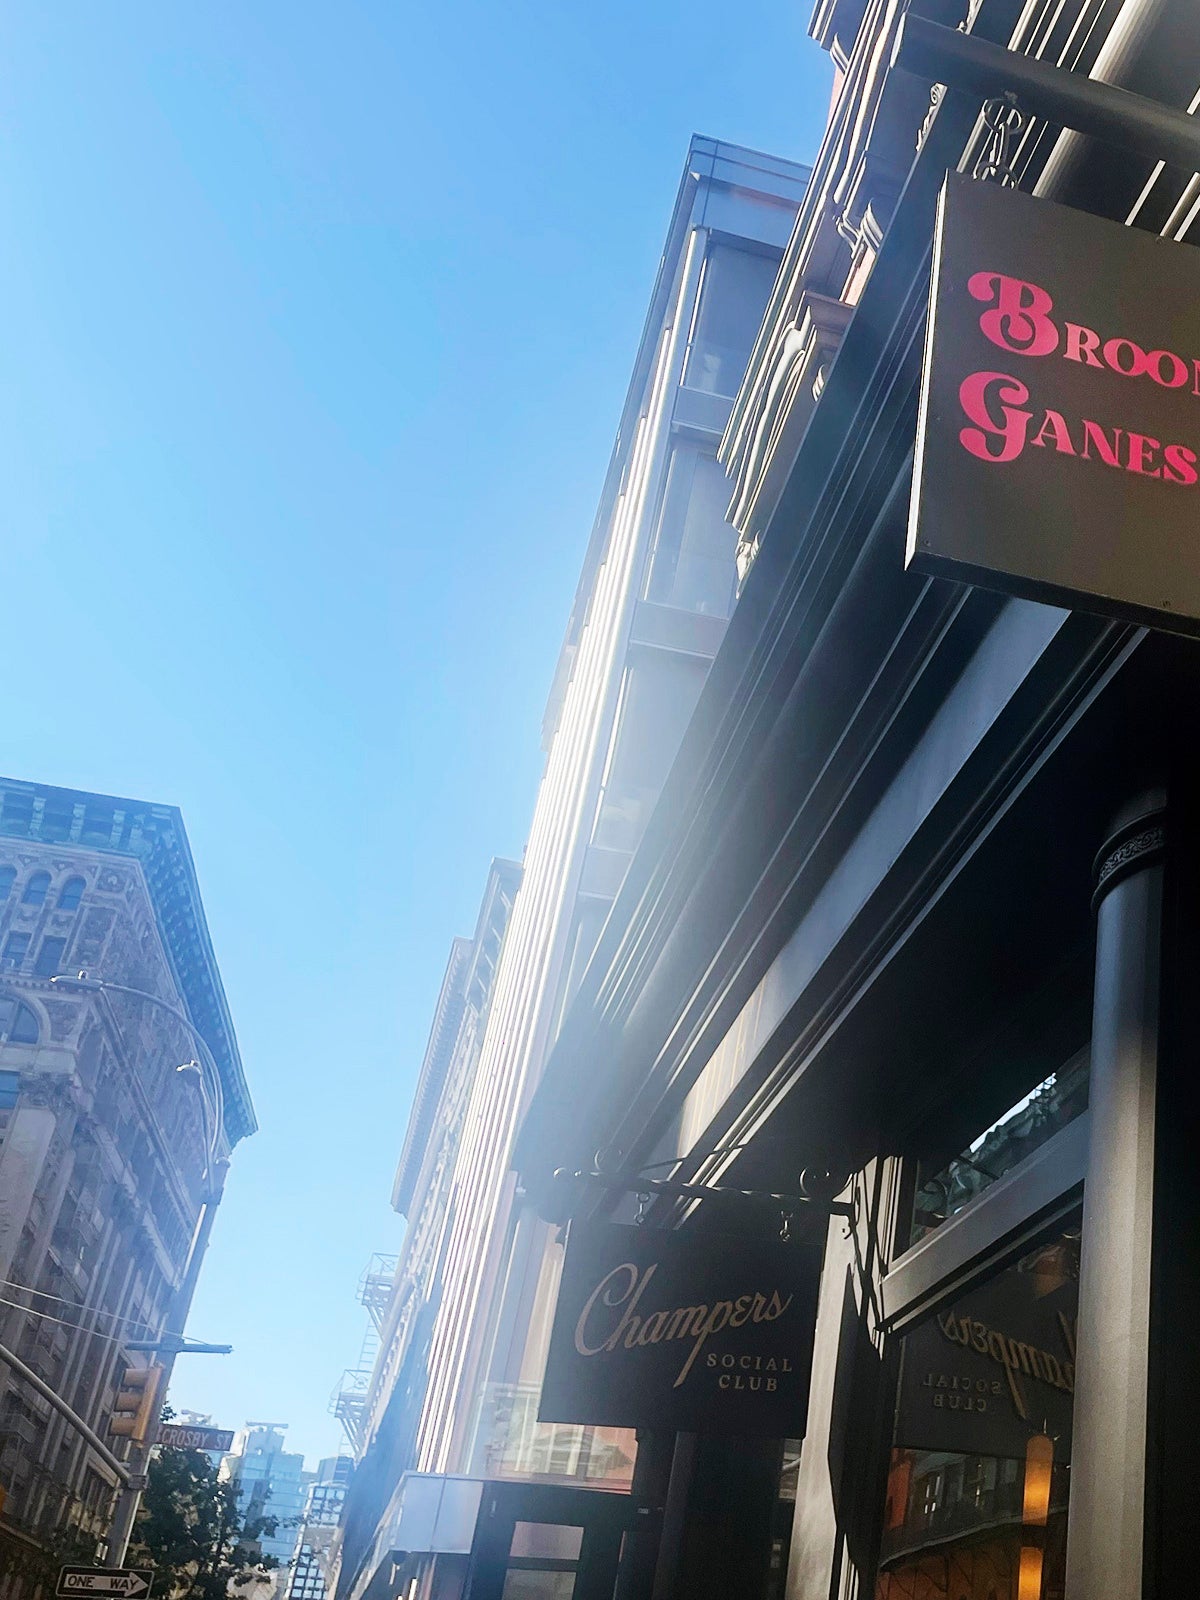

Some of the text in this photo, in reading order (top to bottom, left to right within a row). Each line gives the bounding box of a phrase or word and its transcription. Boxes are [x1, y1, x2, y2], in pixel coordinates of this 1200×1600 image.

[575, 1263, 793, 1388] Champers
[706, 1352, 793, 1373] SOCIAL
[718, 1375, 778, 1392] CLUB
[161, 1428, 232, 1450] CROSBY ST
[67, 1575, 139, 1590] ONE WAY
